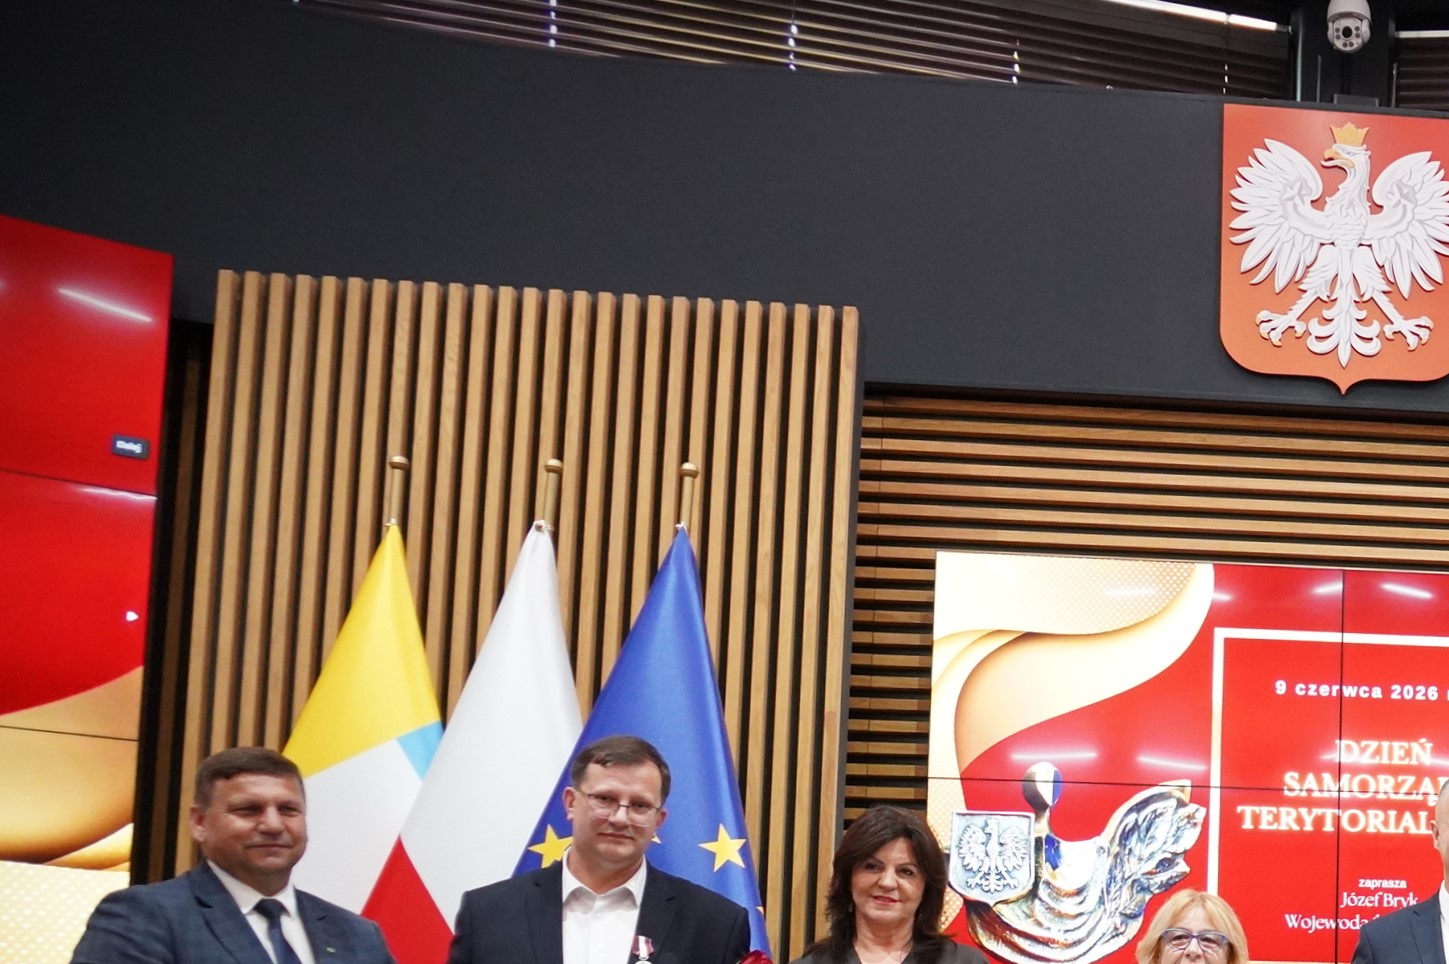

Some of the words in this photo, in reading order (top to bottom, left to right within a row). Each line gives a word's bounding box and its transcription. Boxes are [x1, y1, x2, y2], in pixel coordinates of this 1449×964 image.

[1275, 680, 1286, 695] 9
[1295, 682, 1383, 699] czerwca
[1390, 684, 1439, 701] 2026
[1334, 738, 1434, 766] DZIEŃ
[1283, 771, 1448, 807] SAMORZĄ
[1358, 878, 1407, 890] zaprasza
[1340, 892, 1383, 908] Józef
[1383, 893, 1418, 908] Bryk
